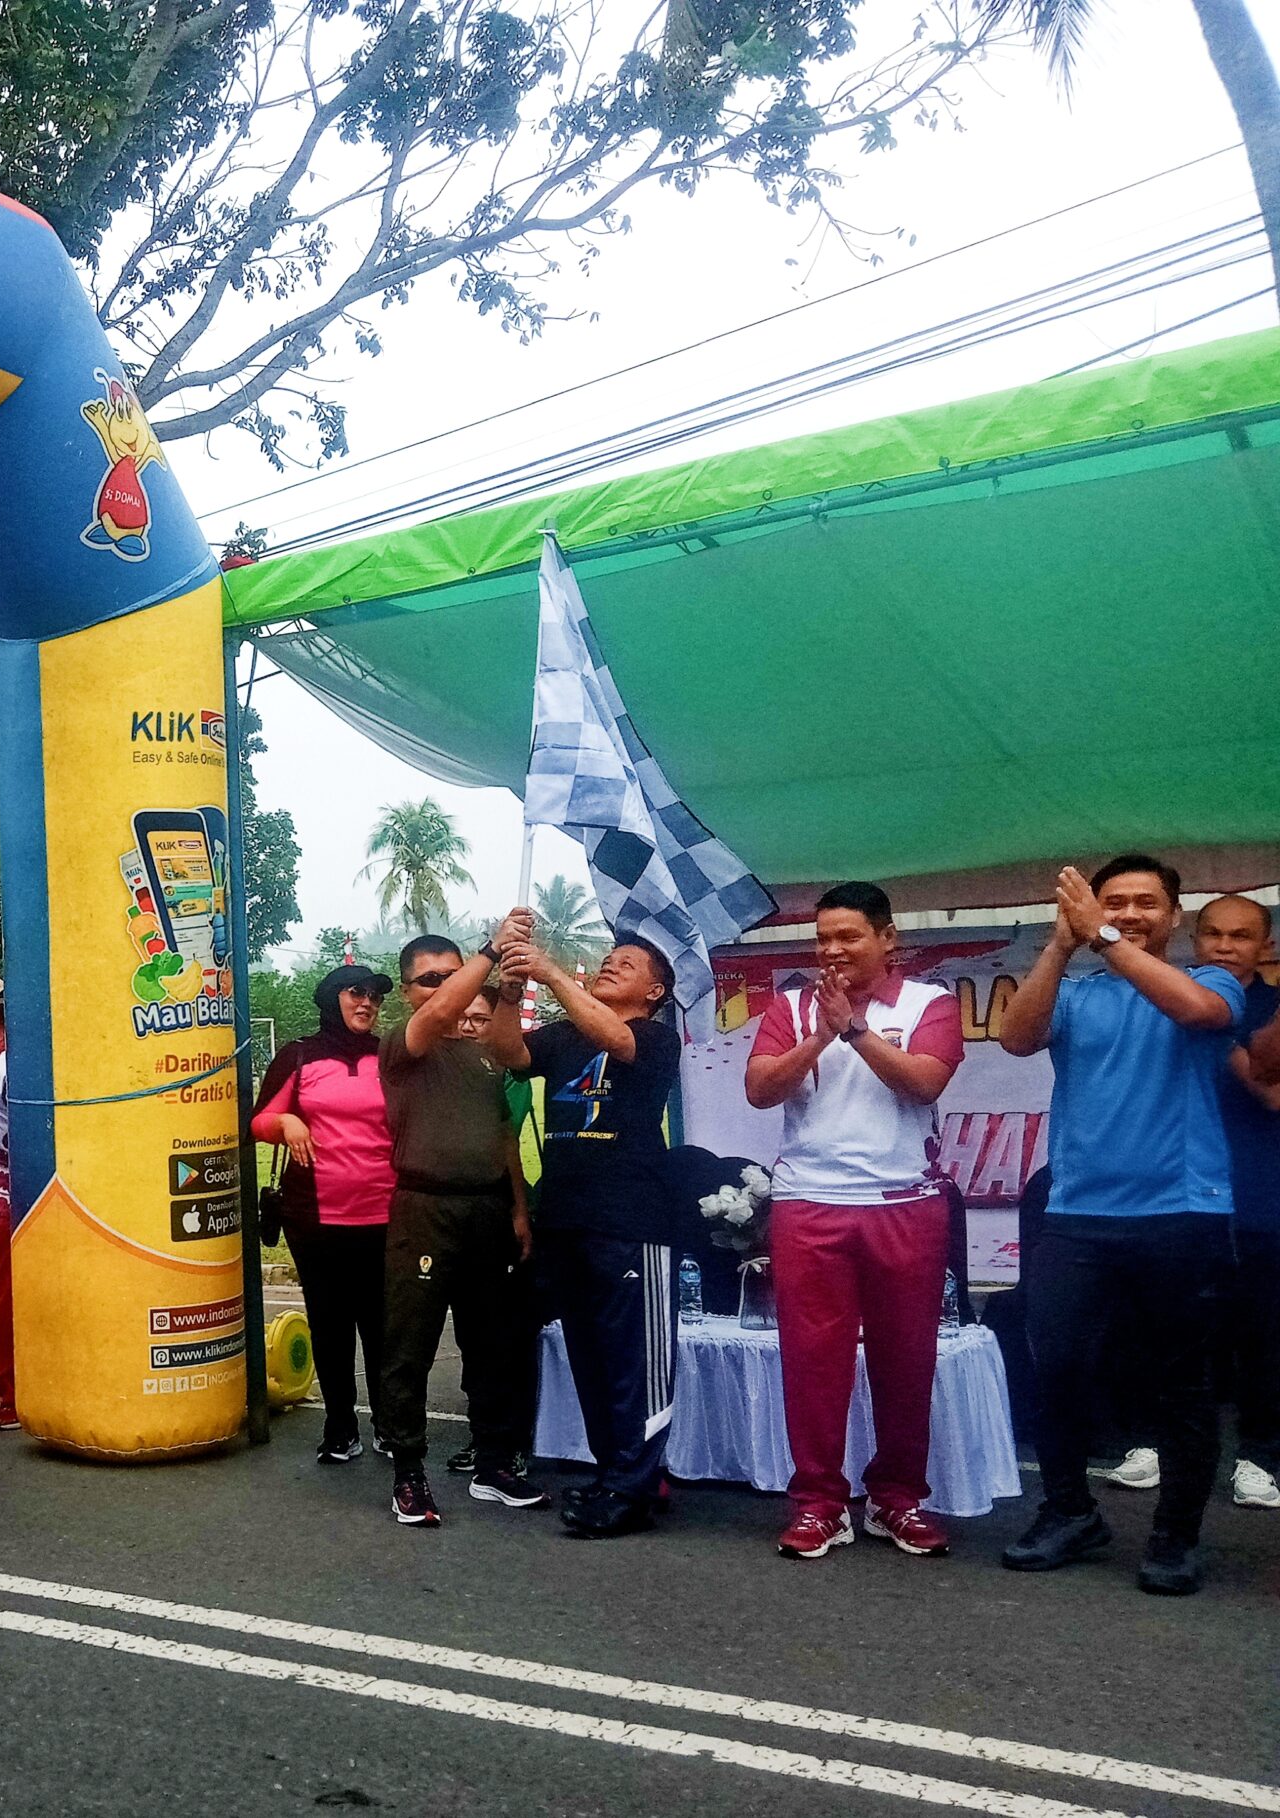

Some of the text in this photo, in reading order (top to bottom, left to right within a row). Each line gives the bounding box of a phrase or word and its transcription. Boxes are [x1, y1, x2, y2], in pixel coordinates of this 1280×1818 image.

[132, 750, 162, 765] Easy
[165, 751, 173, 763] &
[177, 751, 198, 764] Safe
[133, 995, 235, 1037] Mau Belan
[180, 1081, 223, 1104] Gratis
[172, 1136, 221, 1149] Download
[207, 1214, 229, 1233] App
